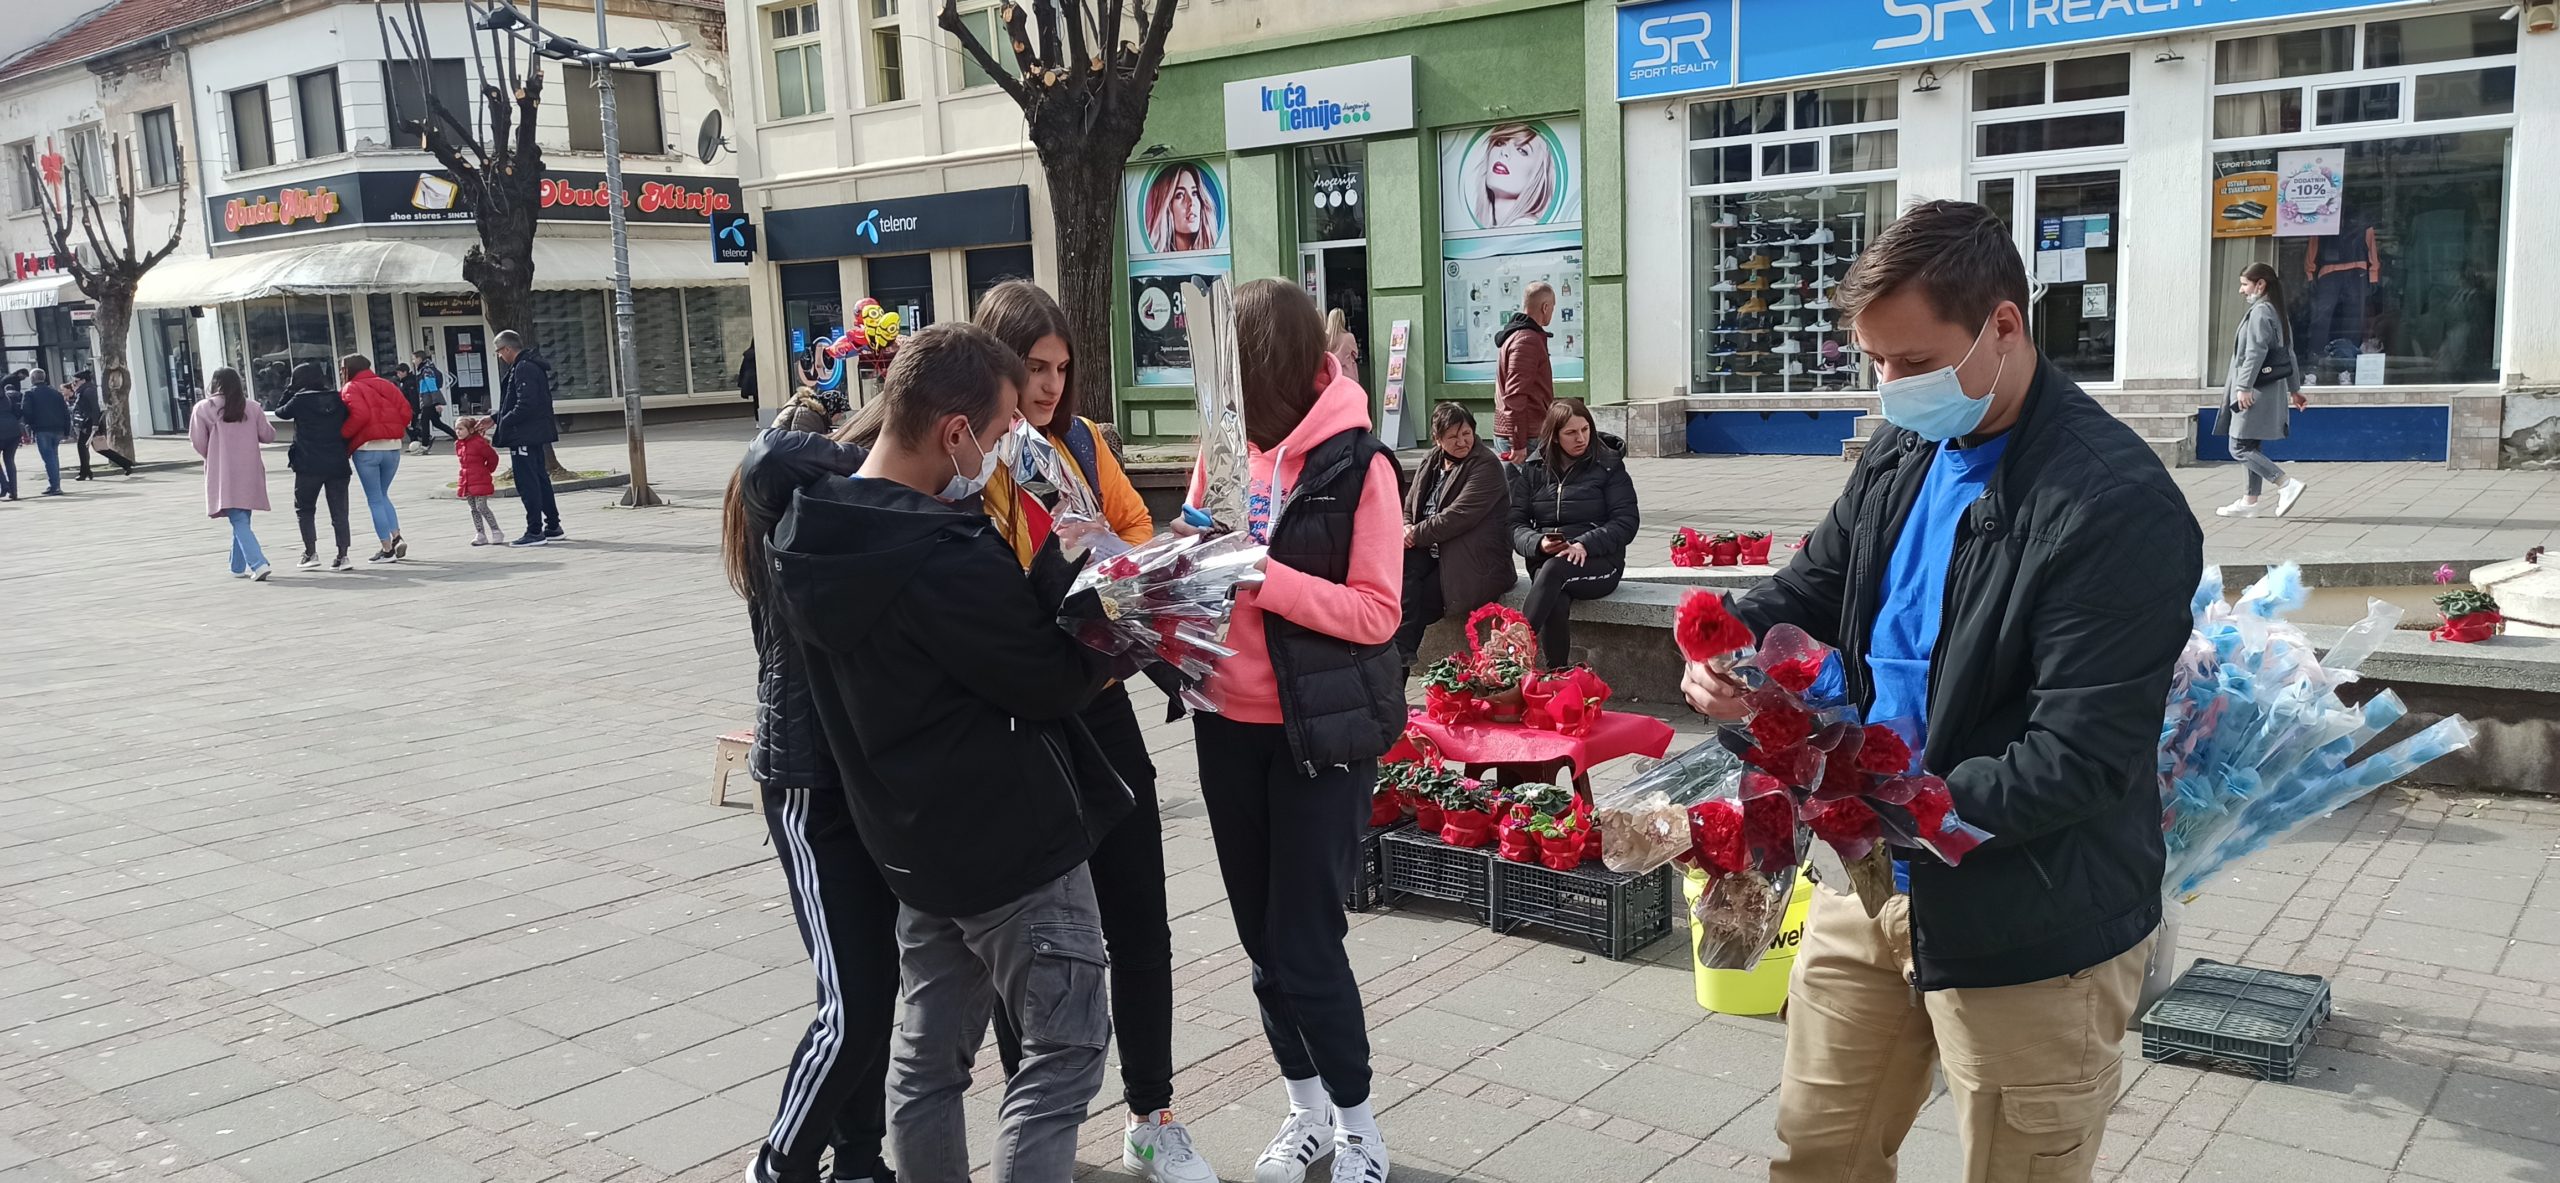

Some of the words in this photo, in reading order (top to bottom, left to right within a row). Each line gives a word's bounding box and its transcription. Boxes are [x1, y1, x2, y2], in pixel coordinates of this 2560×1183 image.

[1633, 11, 1712, 68] SR
[1629, 67, 1668, 80] SPORT
[1671, 60, 1719, 75] REALITY
[1261, 82, 1307, 112] kuća
[1280, 99, 1341, 131] hemije
[2221, 161, 2245, 169] SPORT
[1313, 172, 1360, 191] drogerija
[2291, 184, 2326, 196] -10%
[225, 196, 278, 232] Obuća
[279, 185, 339, 225] Minja
[638, 181, 732, 217] Minja
[390, 212, 412, 221] shoe
[414, 212, 442, 221] stores
[447, 211, 469, 219] SINCE
[879, 214, 918, 233] telenor
[722, 248, 748, 258] telenor
